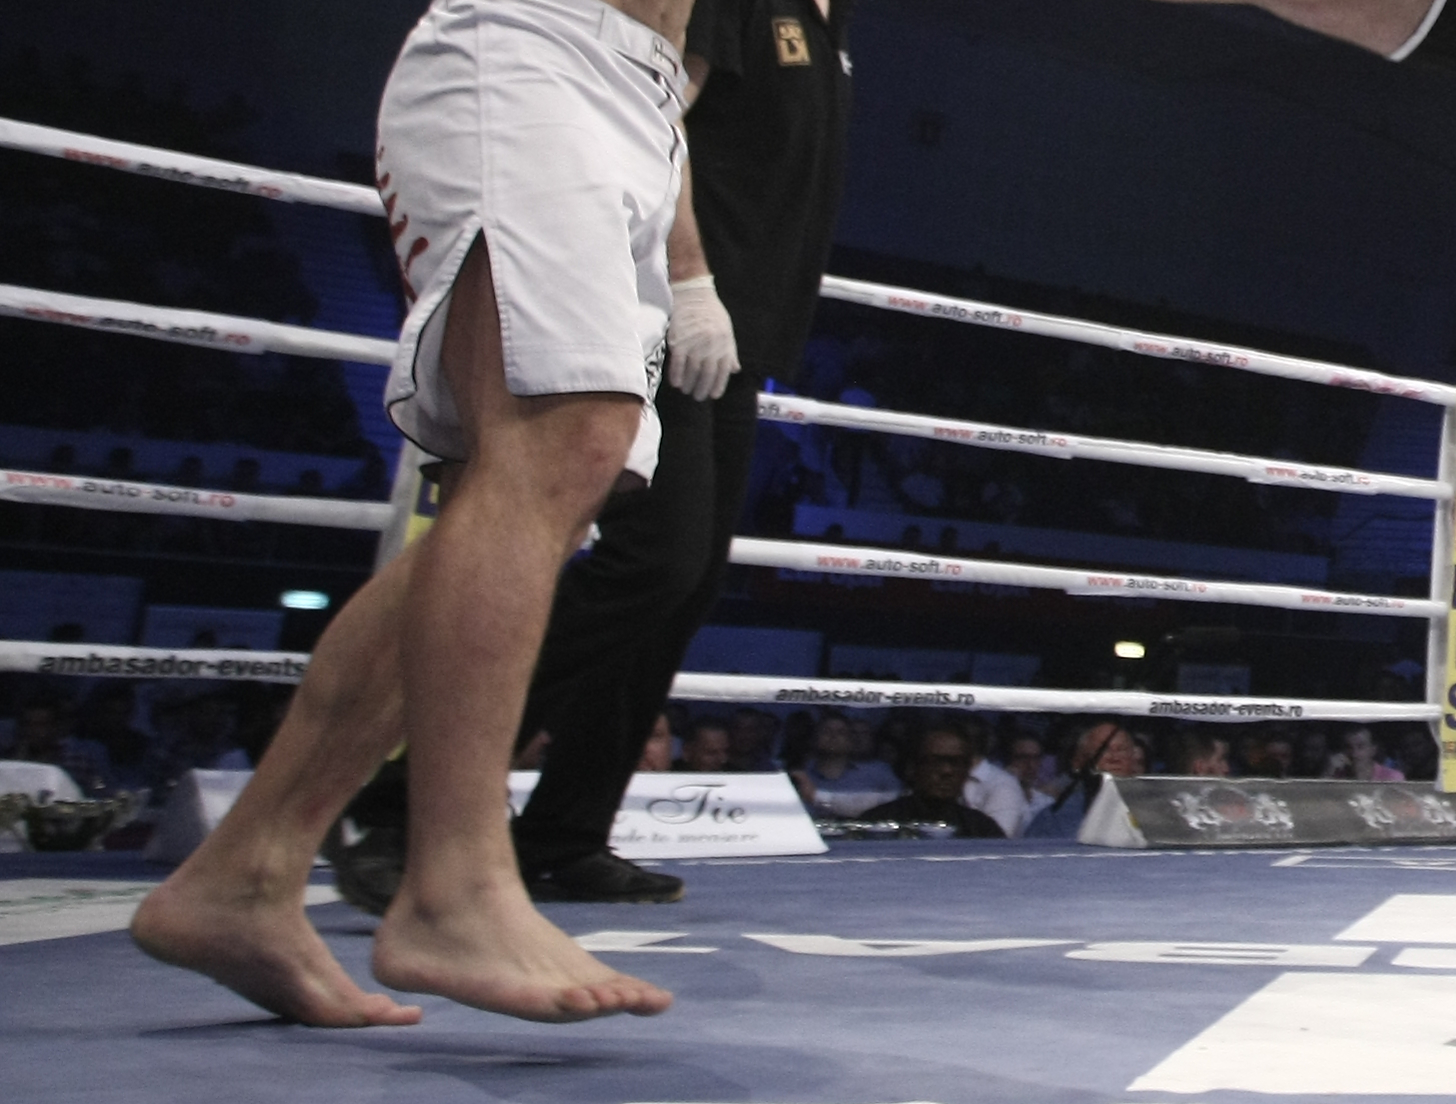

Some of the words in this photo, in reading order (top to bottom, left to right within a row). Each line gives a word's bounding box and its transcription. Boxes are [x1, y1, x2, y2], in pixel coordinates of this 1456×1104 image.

[816, 554, 962, 576] www.auto-soft.ro
[1087, 575, 1208, 594] www.auto-soft.ro
[41, 651, 308, 679] ambasador-events
[1149, 699, 1304, 719] ambasador-events.ro
[646, 783, 749, 825] Tie
